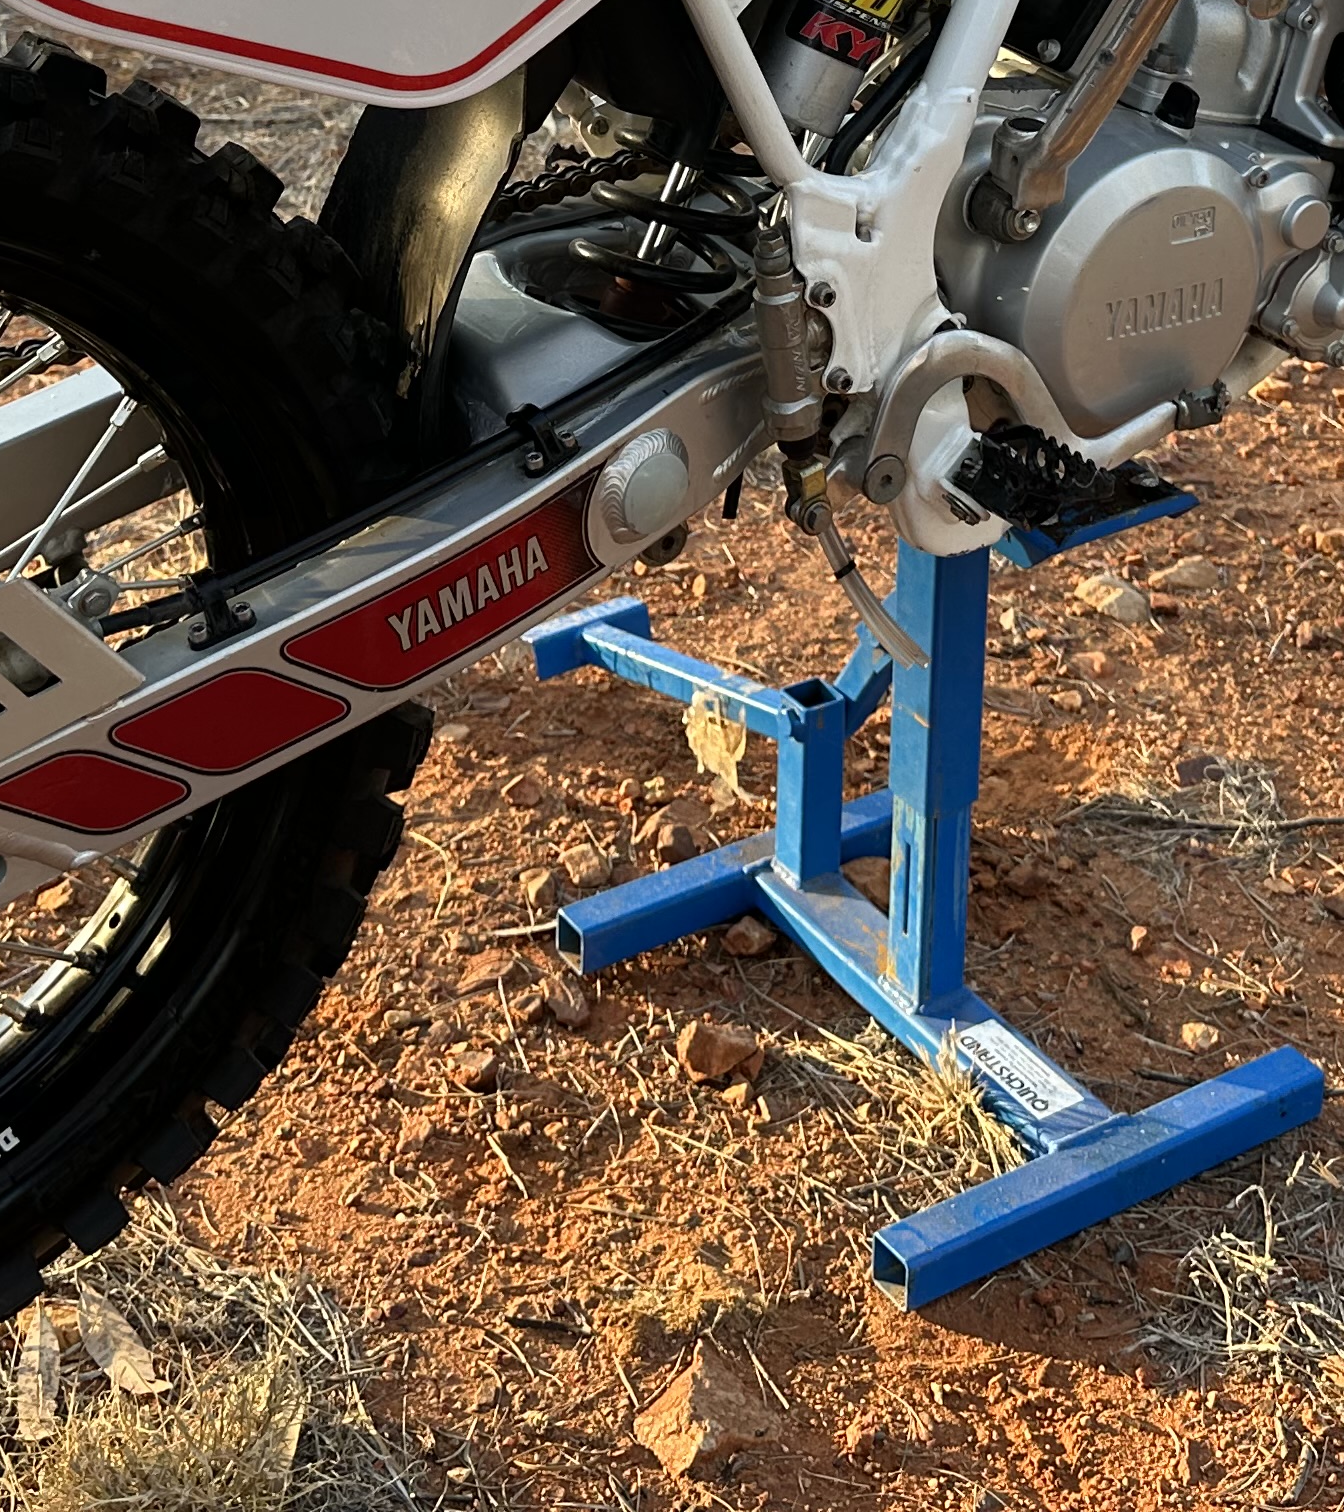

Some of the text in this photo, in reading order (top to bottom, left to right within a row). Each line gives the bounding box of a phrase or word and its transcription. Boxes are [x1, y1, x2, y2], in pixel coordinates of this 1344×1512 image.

[799, 10, 884, 65] KY
[1105, 278, 1224, 342] YAMAHA
[387, 535, 549, 653] YAMAHA
[960, 1035, 1049, 1112] QUICKSTAND
